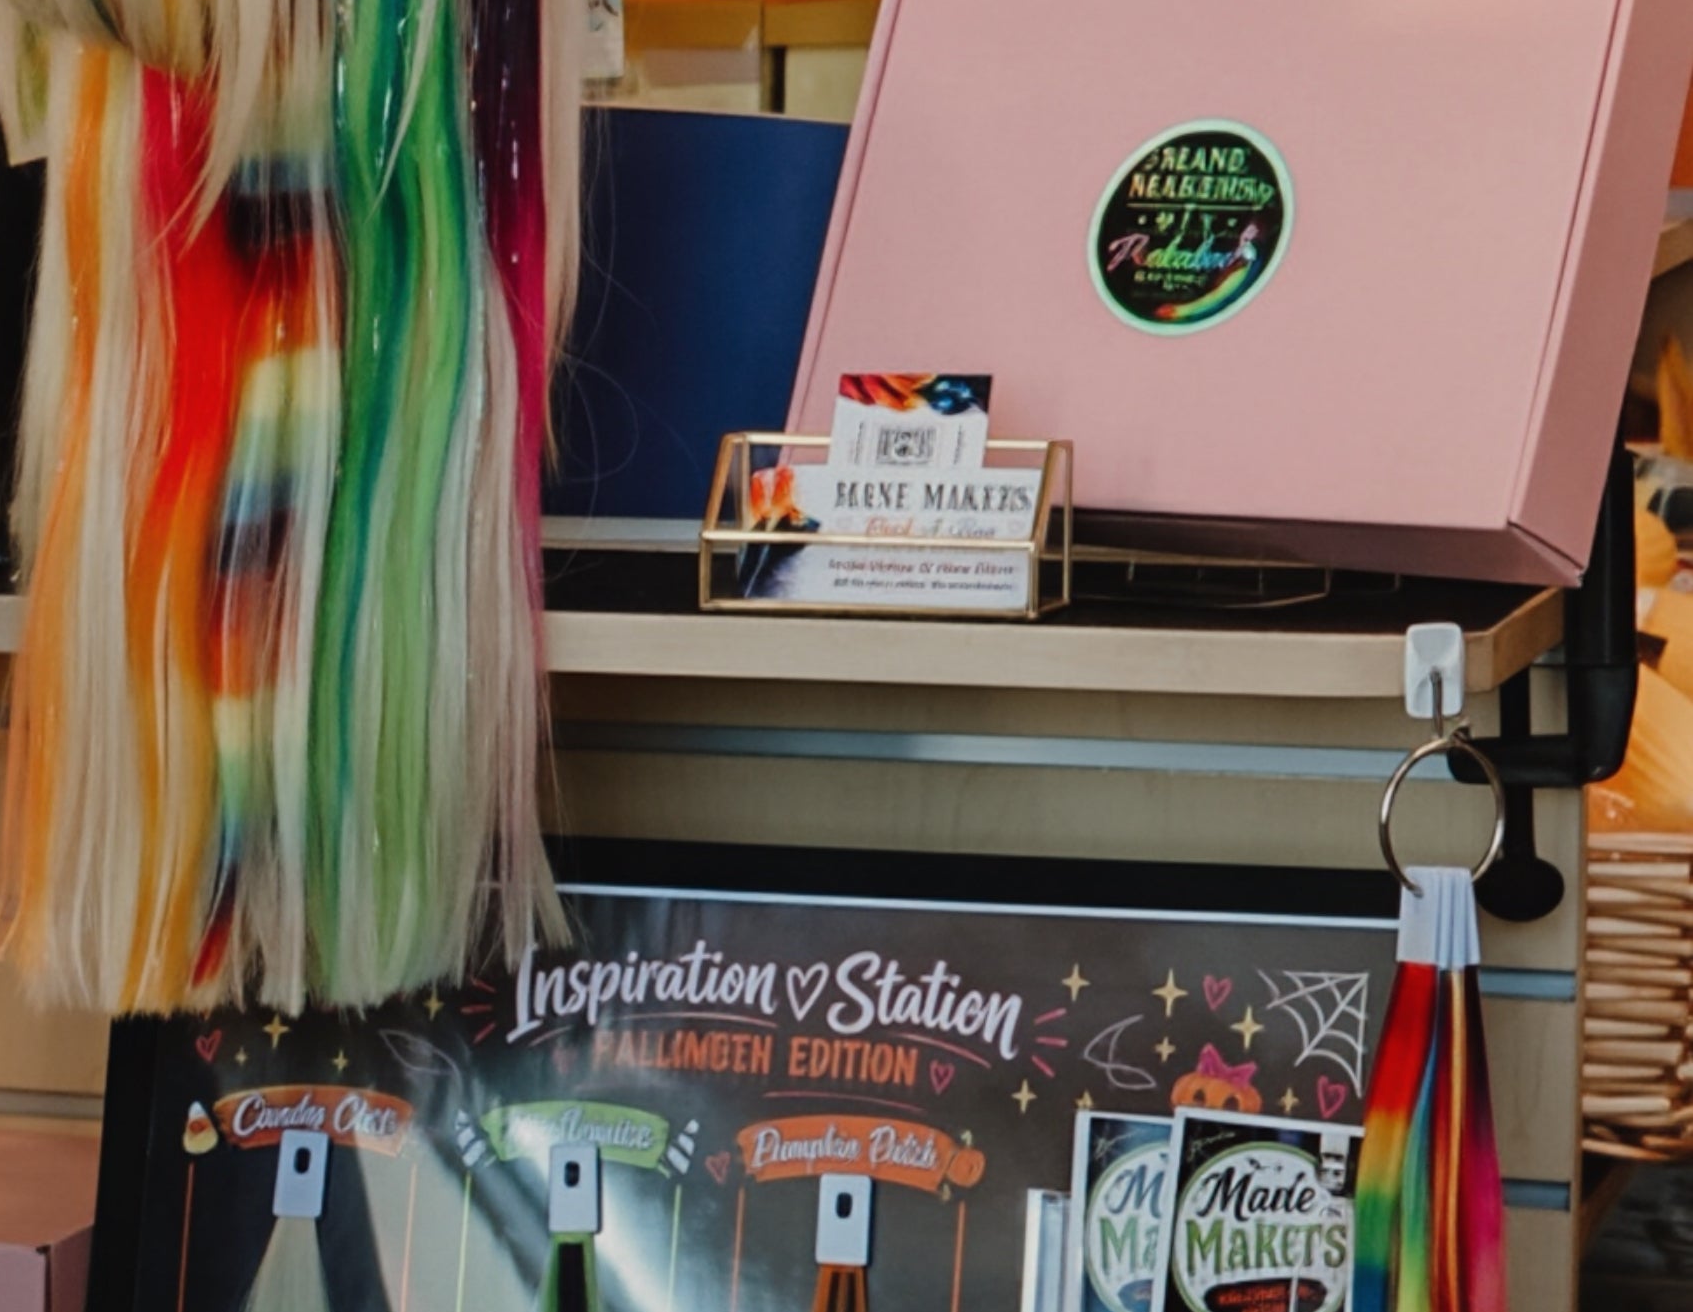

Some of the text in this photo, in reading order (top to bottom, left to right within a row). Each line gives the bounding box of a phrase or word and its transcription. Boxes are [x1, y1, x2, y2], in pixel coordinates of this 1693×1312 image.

[507, 939, 1023, 1059] Inspiration Station
[789, 1037, 918, 1086] EDITION
